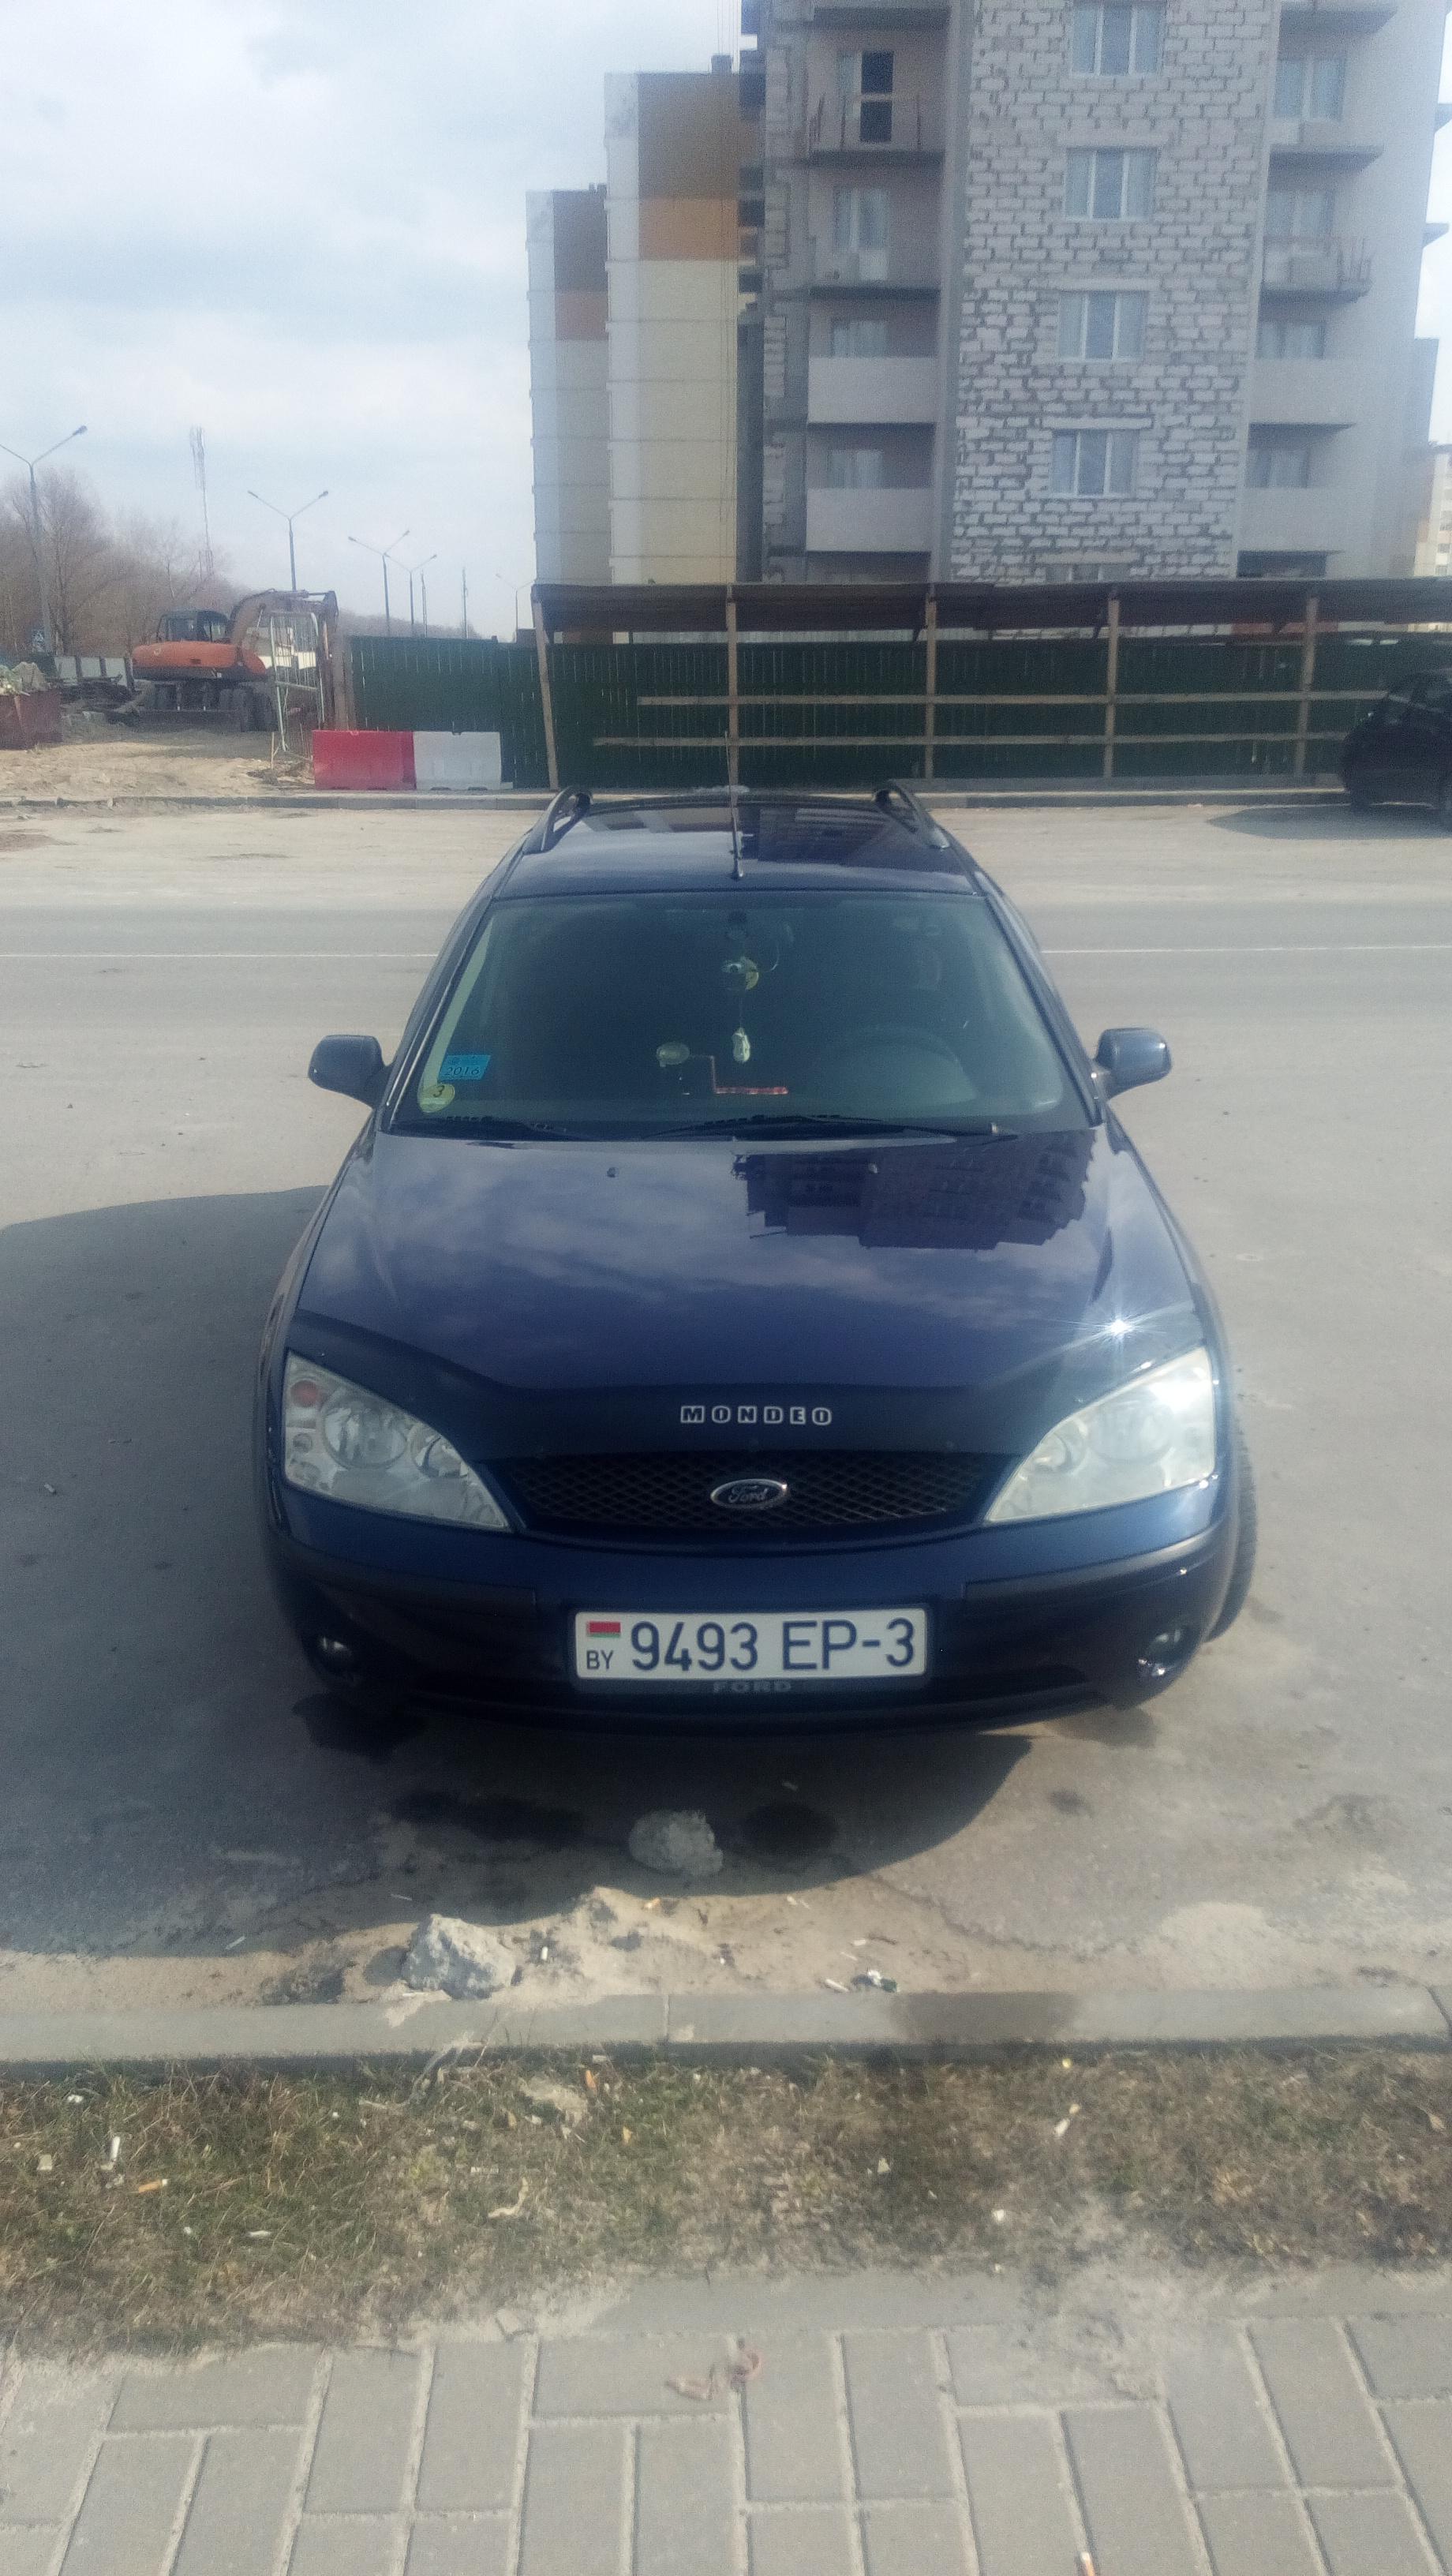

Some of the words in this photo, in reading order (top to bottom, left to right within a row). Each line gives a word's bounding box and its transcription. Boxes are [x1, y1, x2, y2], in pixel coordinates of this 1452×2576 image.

[680, 1406, 832, 1425] MONDEO
[728, 1485, 769, 1503] Ford
[631, 1621, 758, 1671] 9493
[782, 1618, 914, 1670] EP-3
[586, 1650, 613, 1670] BY
[713, 1681, 791, 1693] FORD
